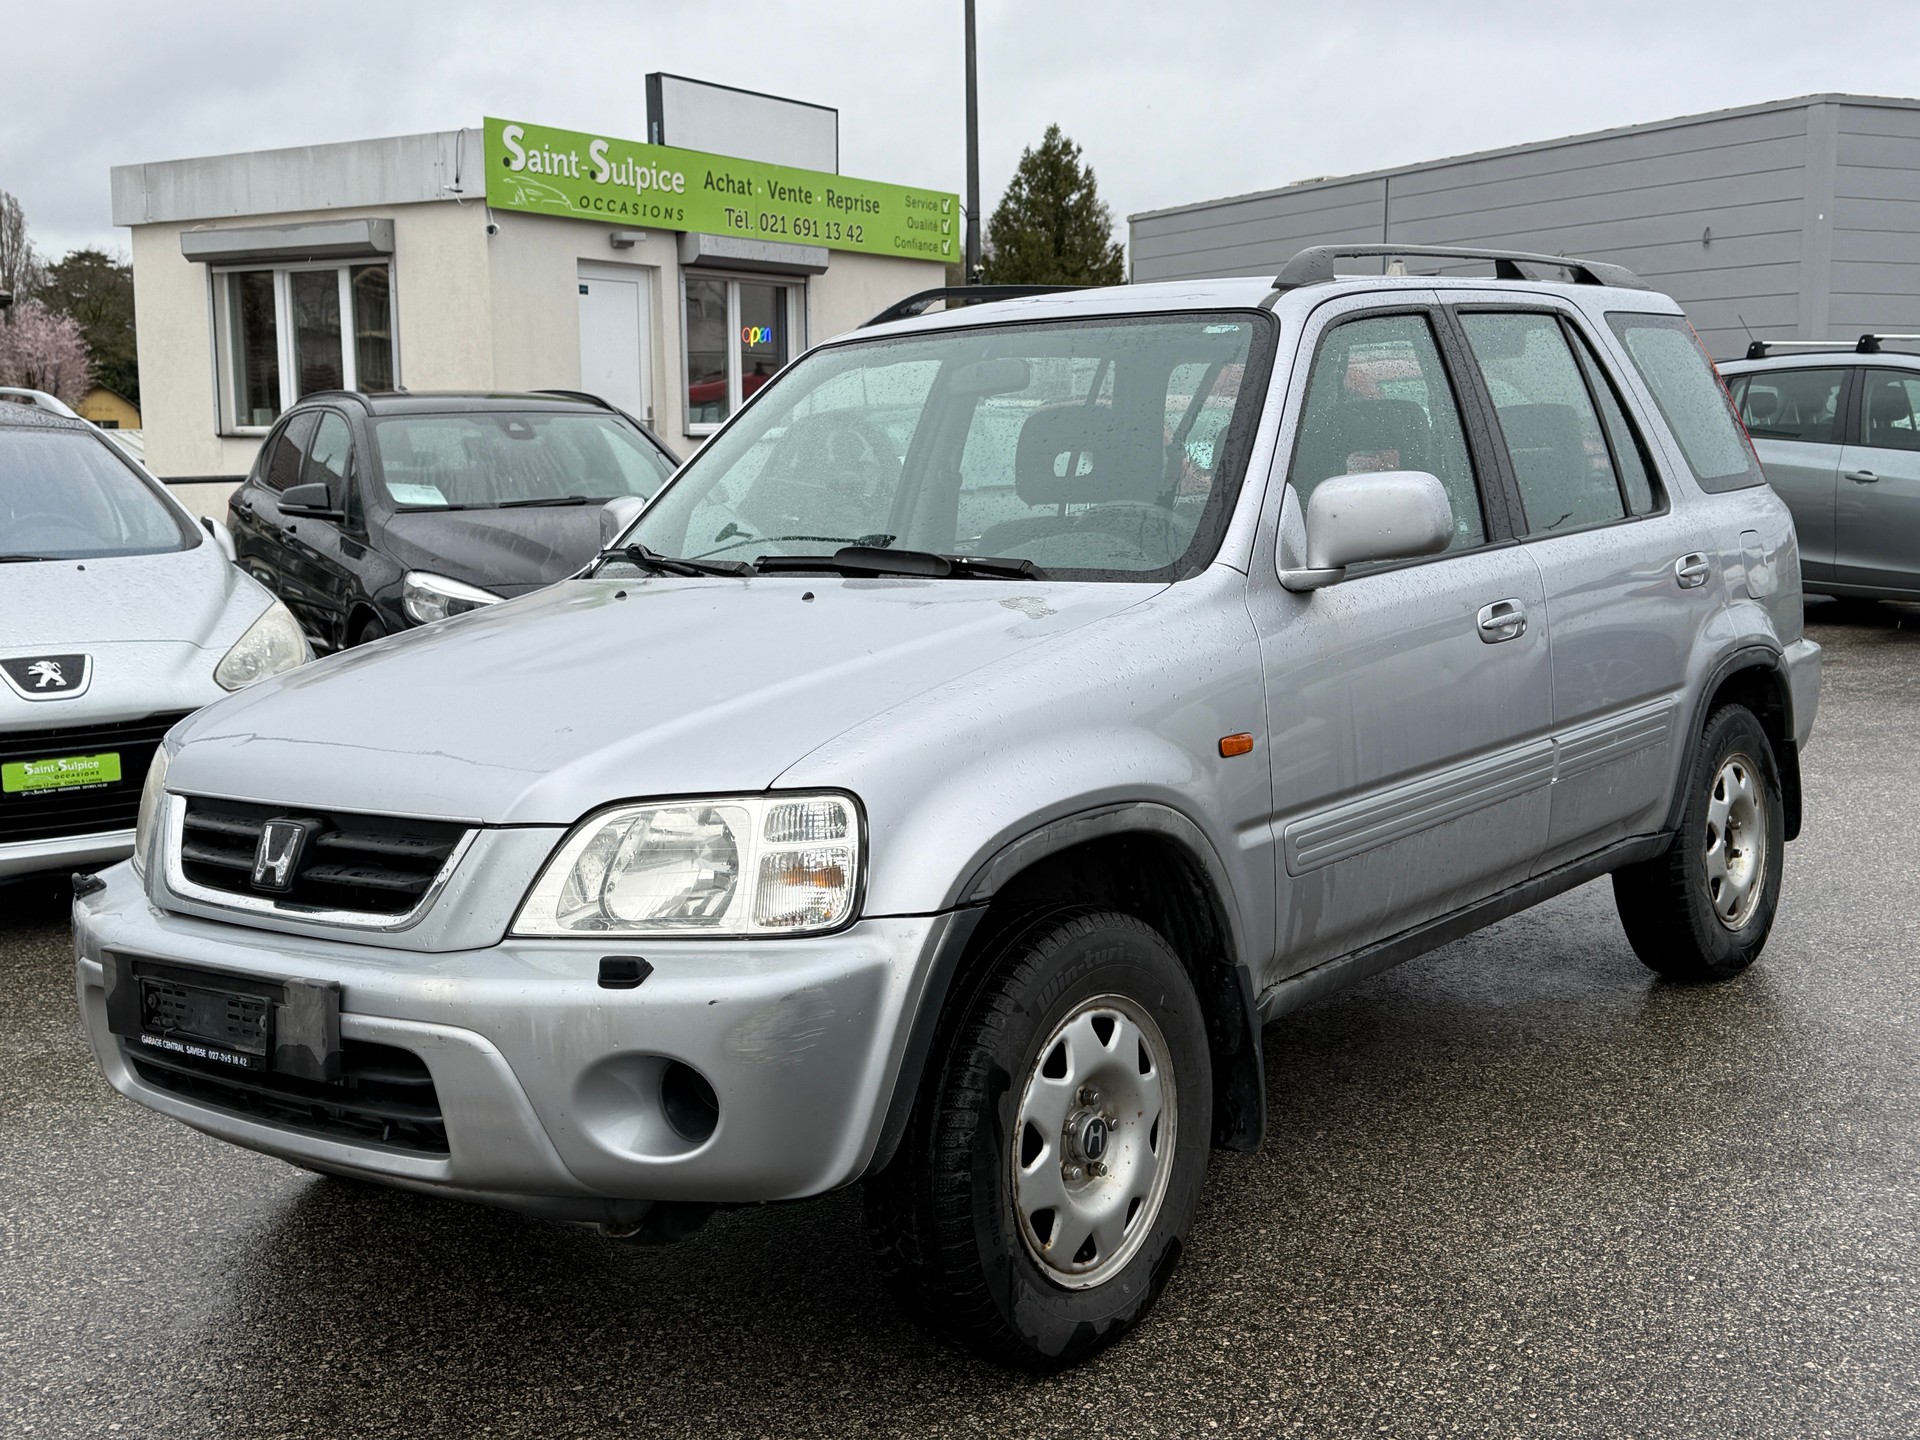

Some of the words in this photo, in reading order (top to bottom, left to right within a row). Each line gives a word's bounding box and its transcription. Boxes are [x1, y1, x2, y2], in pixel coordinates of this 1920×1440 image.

[502, 125, 685, 195] Saint-Sulpice
[704, 170, 753, 196] Achat
[767, 180, 812, 205] Vente
[826, 189, 880, 214] Reprise
[579, 196, 684, 221] OCCASIONS
[905, 195, 938, 212] Service
[724, 208, 754, 230] Tél.
[759, 213, 787, 234] 021
[793, 217, 819, 238] 691
[825, 221, 841, 240] 13
[846, 225, 864, 243] 42
[907, 216, 938, 231] Qualité
[894, 236, 938, 253] Confiance
[742, 326, 772, 347] open
[54, 770, 100, 780] OCCASIONS
[141, 1034, 162, 1048] GARAGE
[163, 1039, 184, 1053] CENTRAL
